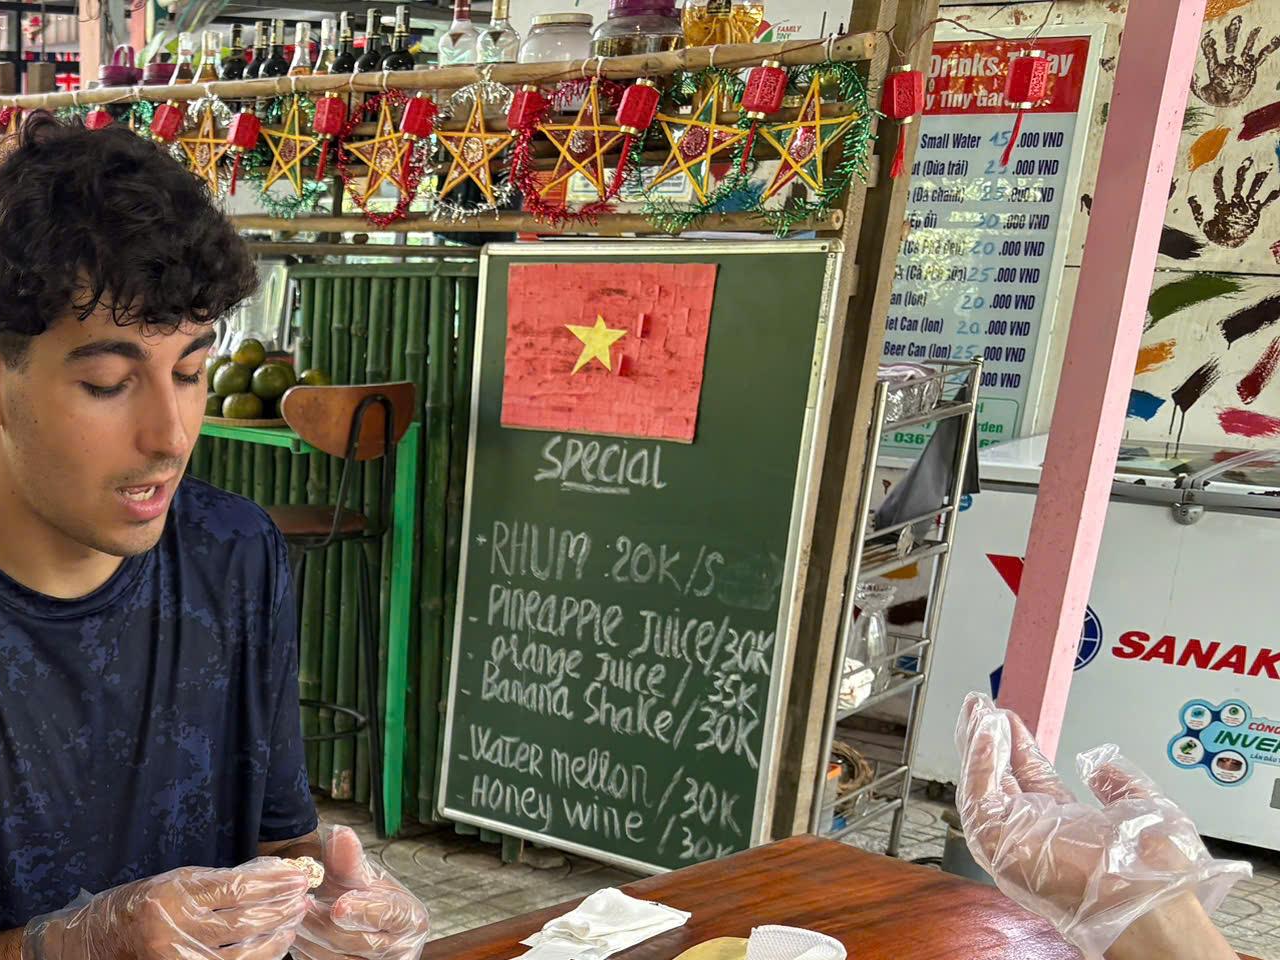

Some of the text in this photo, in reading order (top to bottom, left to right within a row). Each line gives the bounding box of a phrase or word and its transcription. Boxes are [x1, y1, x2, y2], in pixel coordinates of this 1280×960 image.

[777, 25, 802, 33] FAMILY
[928, 52, 999, 77] Drinks
[939, 91, 973, 109] Tiny
[920, 133, 949, 149] Small
[952, 132, 982, 149] Water
[1042, 131, 1064, 148] VND
[1012, 160, 1035, 175] .000
[1037, 159, 1059, 175] VND
[1031, 187, 1055, 203] ND
[1028, 214, 1050, 229] VND
[998, 240, 1021, 256] .000
[1024, 241, 1045, 257] VND
[993, 267, 1017, 283] .000
[1018, 268, 1040, 284] VND
[961, 295, 984, 310] 20
[989, 294, 1012, 309] .000
[1014, 295, 1035, 310] VND
[900, 317, 919, 332] Can
[920, 317, 944, 334] (lon)
[957, 320, 980, 335] 20
[984, 320, 1007, 335] .000
[1009, 321, 1030, 337] VND
[883, 341, 906, 357] Beer
[908, 342, 927, 357] Can
[928, 344, 952, 360] (lon)
[1004, 347, 1026, 363] VND
[1000, 373, 1021, 388] VND
[481, 660, 574, 720] Banana
[471, 774, 552, 832] Honey
